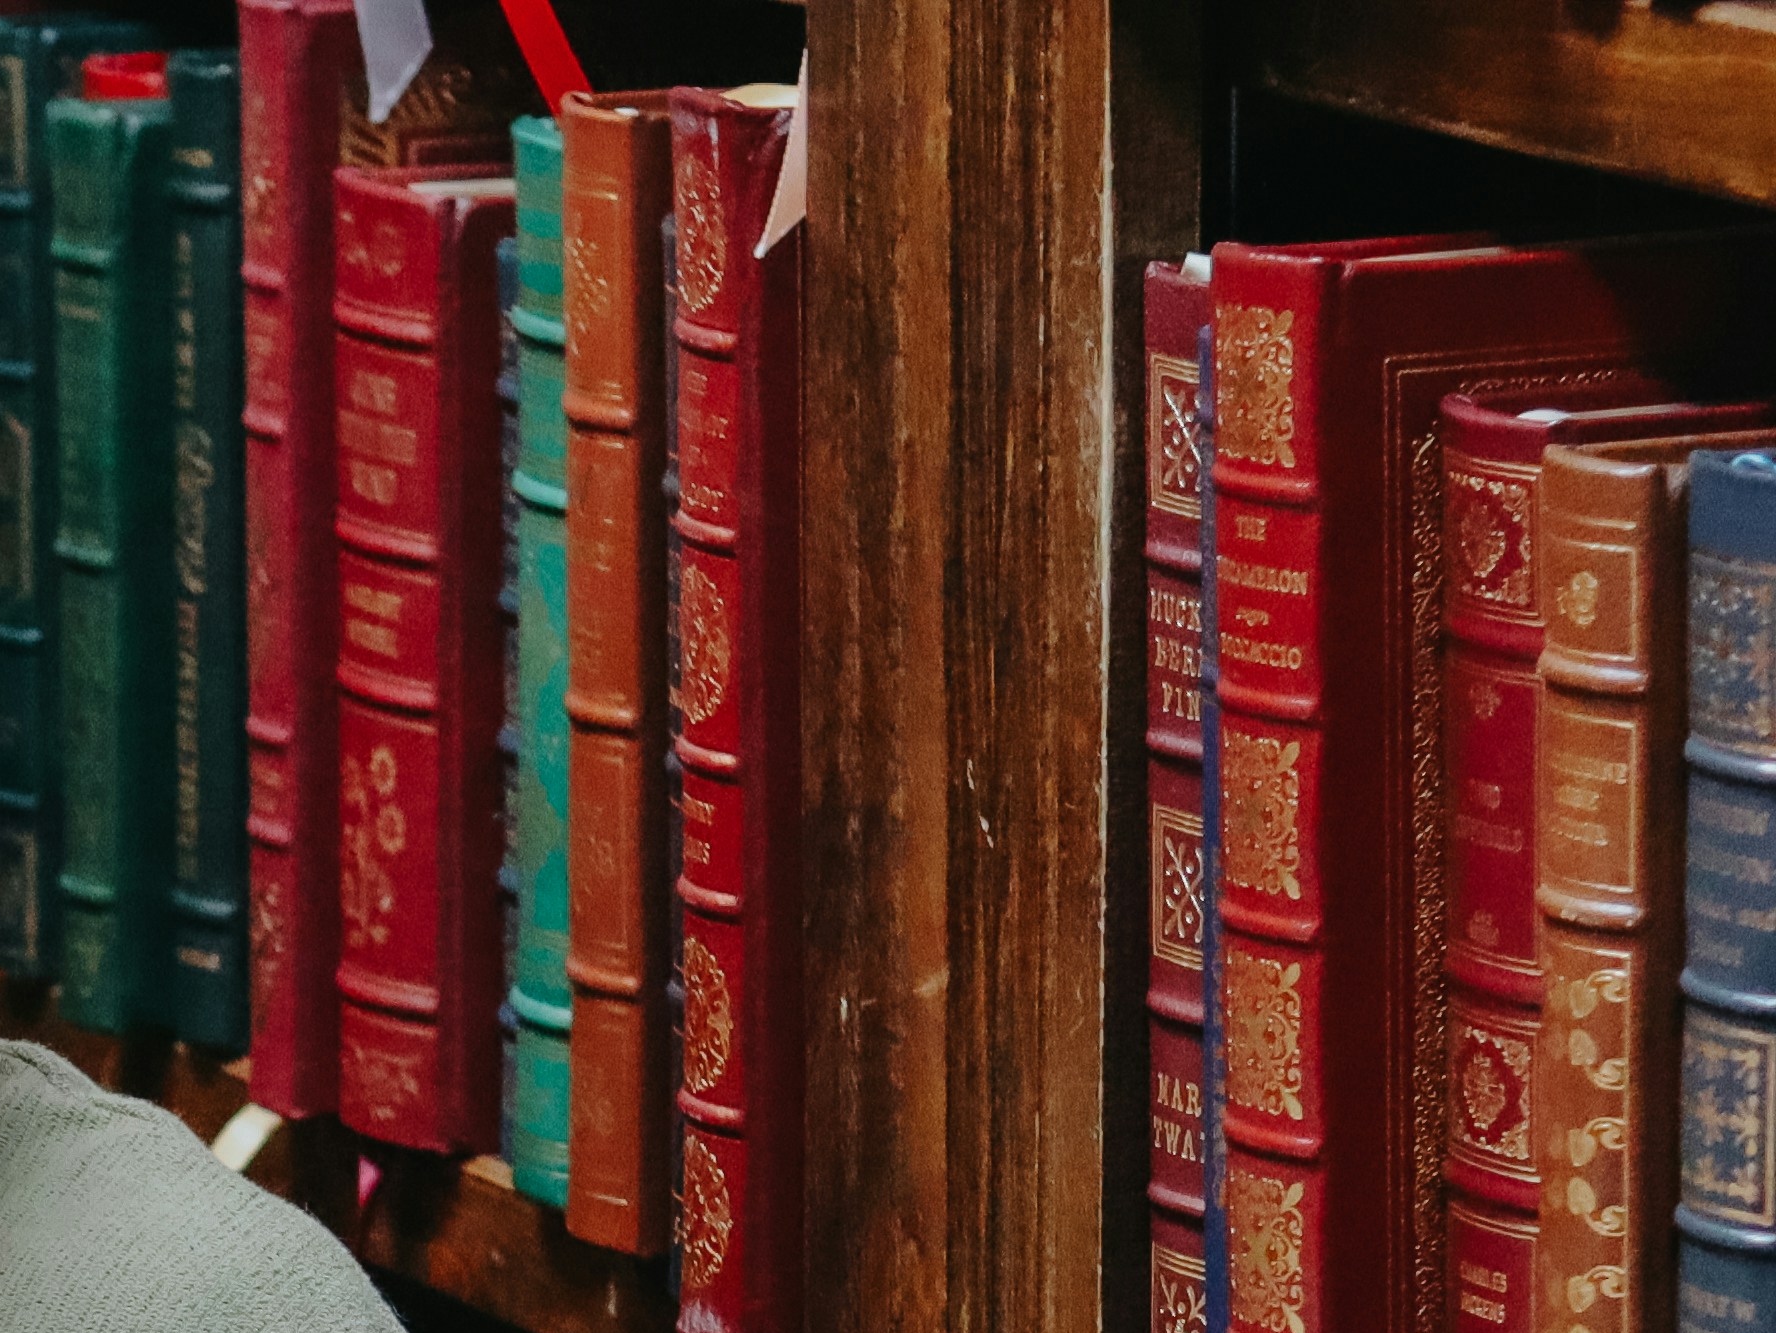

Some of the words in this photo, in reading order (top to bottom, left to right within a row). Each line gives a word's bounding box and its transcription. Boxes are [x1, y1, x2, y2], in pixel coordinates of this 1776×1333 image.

[1235, 515, 1268, 541] THE
[1150, 587, 1203, 632] HUCK
[1161, 681, 1201, 722] FIN
[1157, 1071, 1203, 1118] MAR
